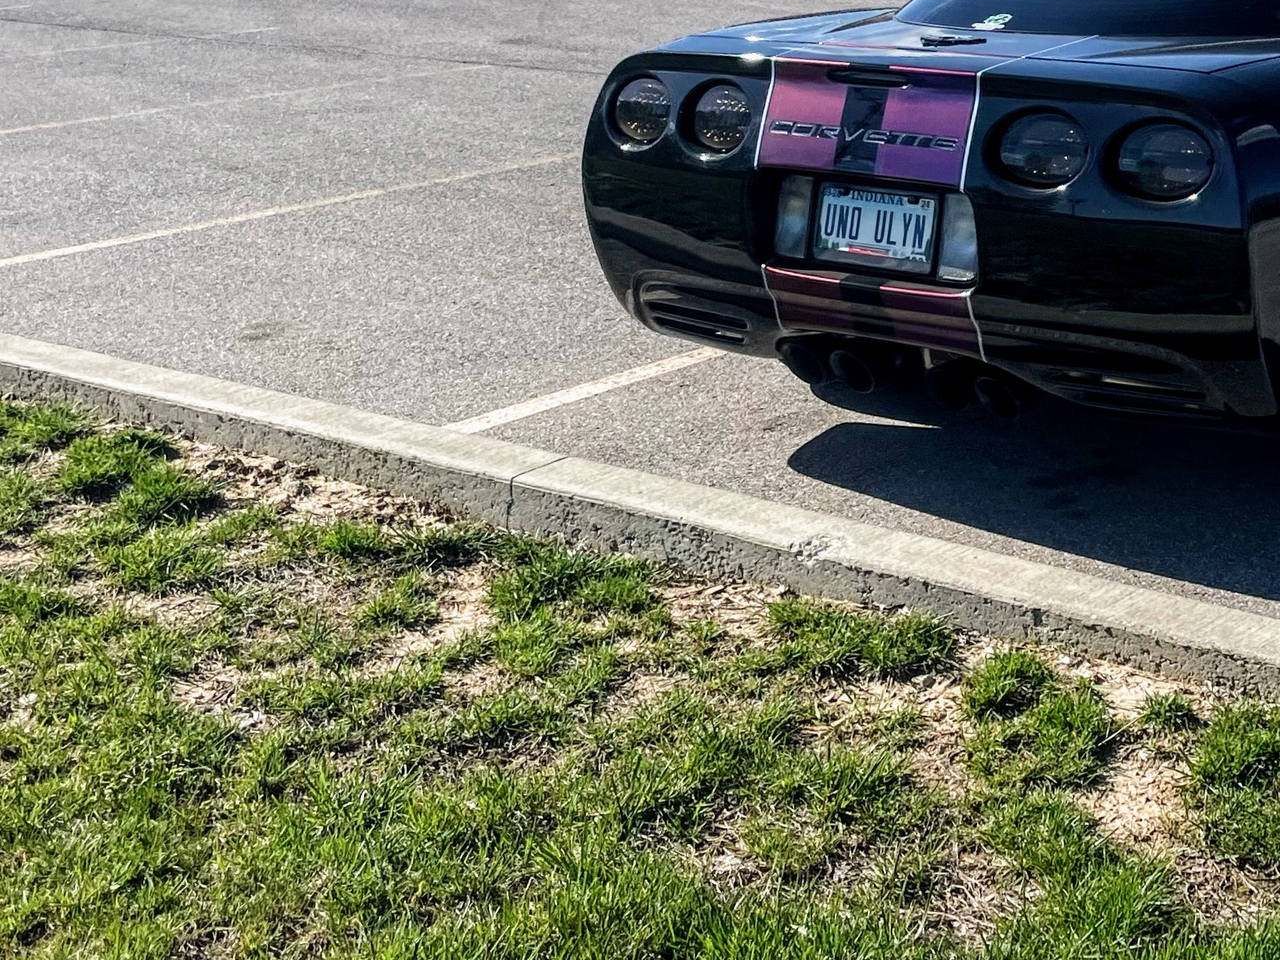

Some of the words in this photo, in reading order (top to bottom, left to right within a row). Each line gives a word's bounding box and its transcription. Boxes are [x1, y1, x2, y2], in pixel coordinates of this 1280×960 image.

[769, 120, 959, 150] CORVETTE
[851, 190, 904, 206] INDIANA
[824, 203, 862, 241] UNO
[874, 209, 926, 249] ULYN
